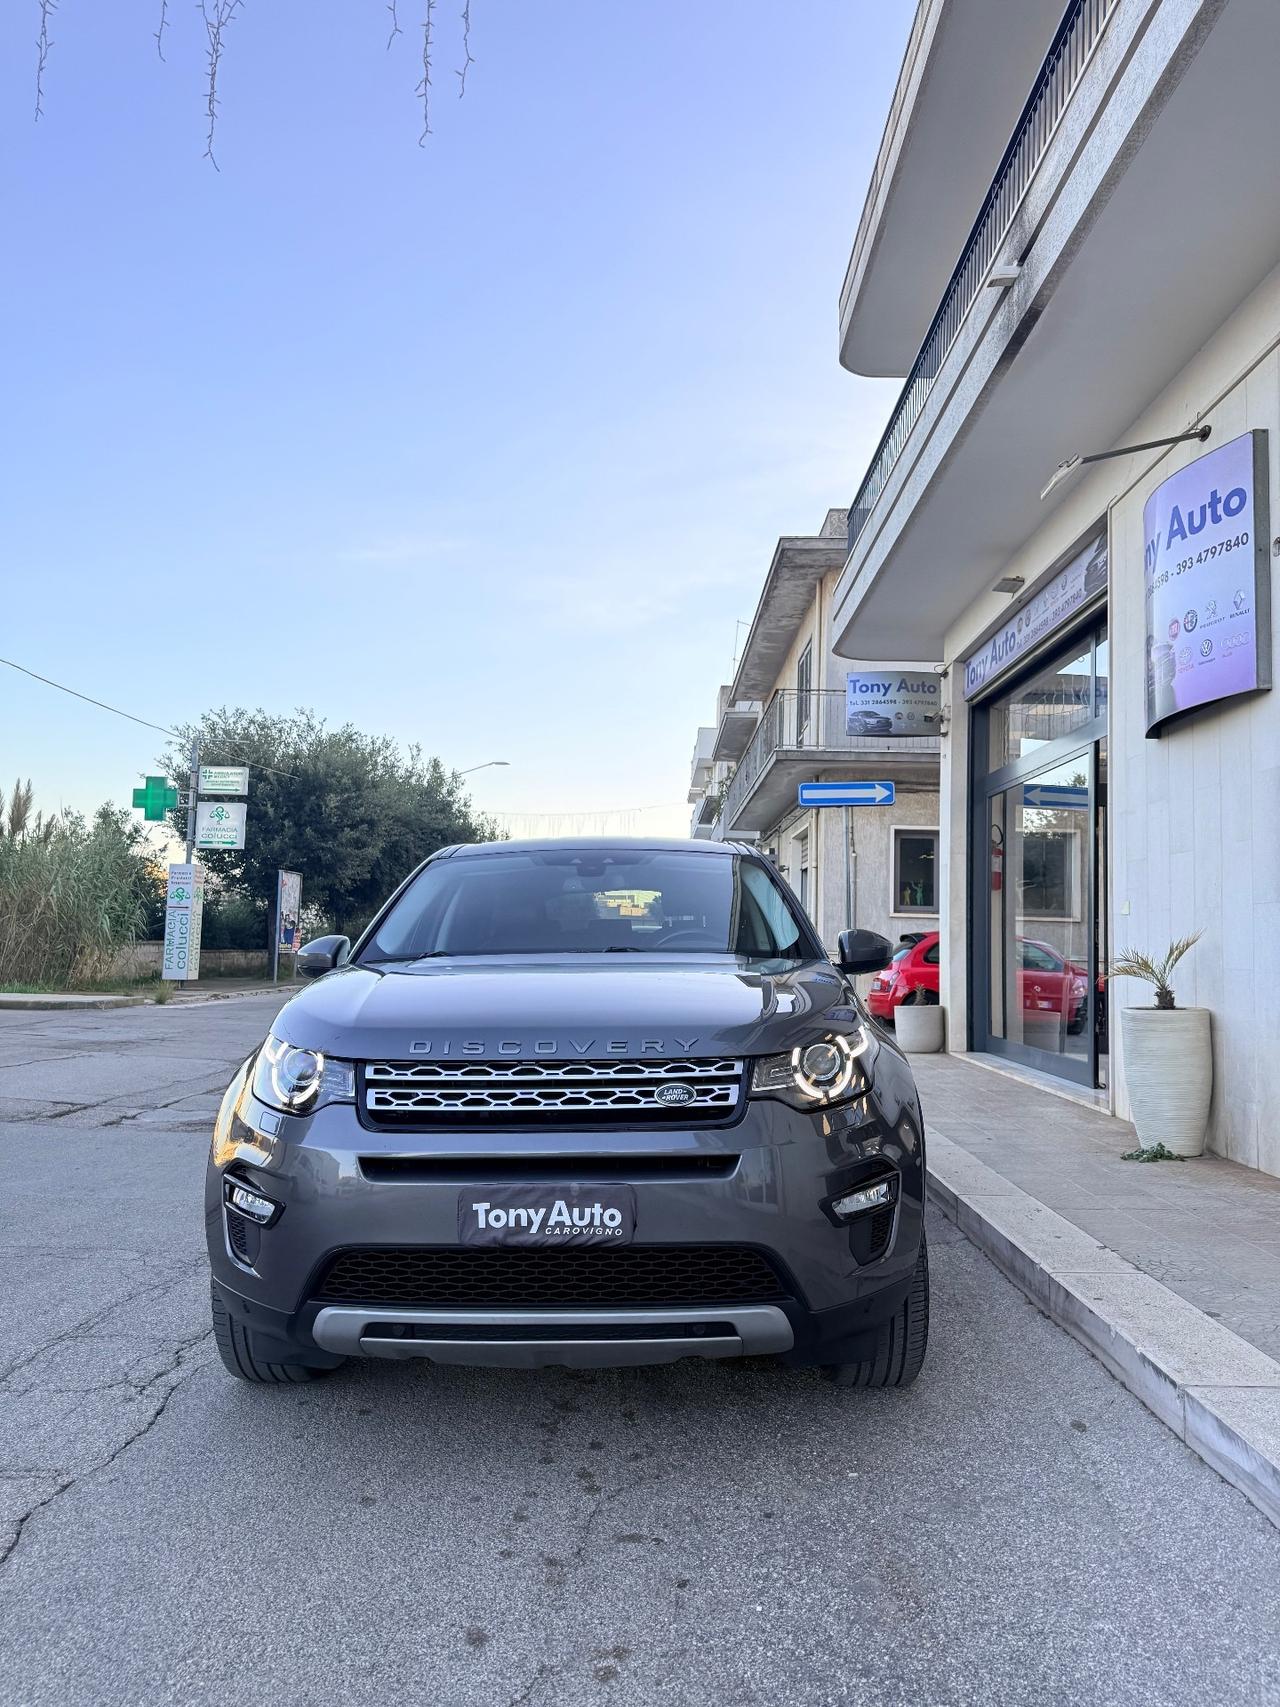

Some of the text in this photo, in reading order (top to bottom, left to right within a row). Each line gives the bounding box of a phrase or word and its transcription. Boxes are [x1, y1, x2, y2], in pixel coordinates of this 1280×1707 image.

[1166, 487, 1247, 551] Auto
[1176, 557, 1194, 576] 393
[1196, 532, 1249, 564] 4797840
[965, 631, 1016, 689] Tony Auto
[849, 678, 937, 697] Tony Auto
[165, 910, 177, 970] FARMACIA
[408, 1037, 700, 1055] DISCOVERY
[472, 1200, 622, 1234] Tony Auto
[544, 1226, 623, 1237] CAROVIGNO
